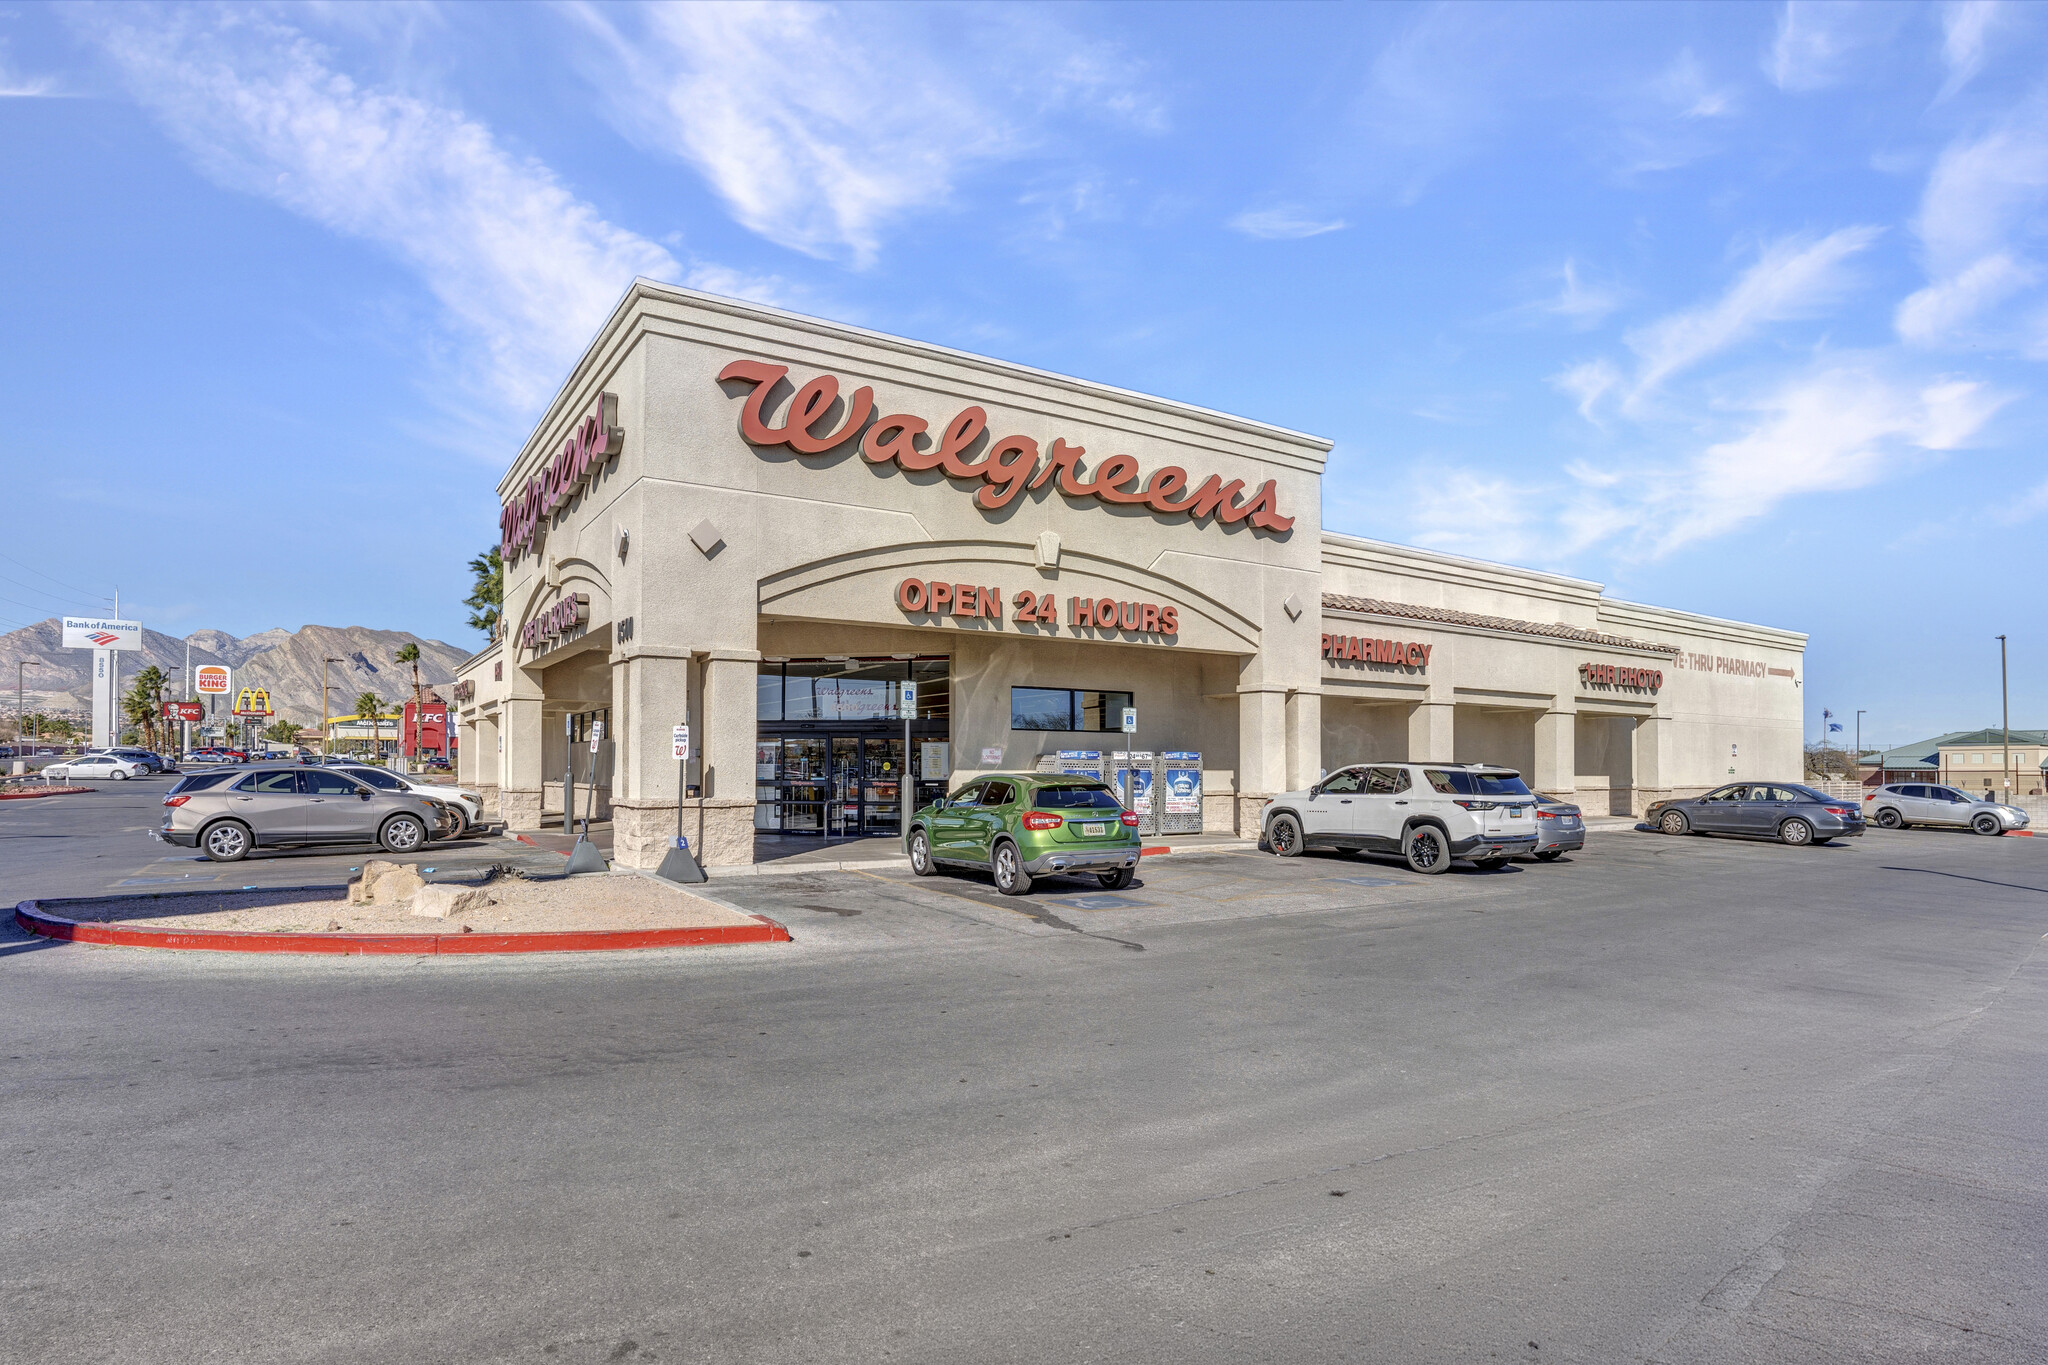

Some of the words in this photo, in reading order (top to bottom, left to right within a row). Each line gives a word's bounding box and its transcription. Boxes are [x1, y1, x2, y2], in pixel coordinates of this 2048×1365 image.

[717, 359, 1295, 532] Walgreens
[551, 592, 581, 634] HOURS
[898, 578, 1000, 617] OPEN
[1014, 590, 1057, 623] 24
[1070, 597, 1178, 635] HOURS
[66, 620, 90, 628] Bank
[90, 621, 100, 629] of
[101, 622, 138, 631] America
[1321, 634, 1433, 666] PHARMACY
[1584, 662, 1615, 684] 1-HR
[1619, 667, 1663, 689] PHOTO
[1716, 656, 1766, 678] PHARMACY
[199, 680, 227, 688] KING
[816, 687, 874, 696] Walgreens
